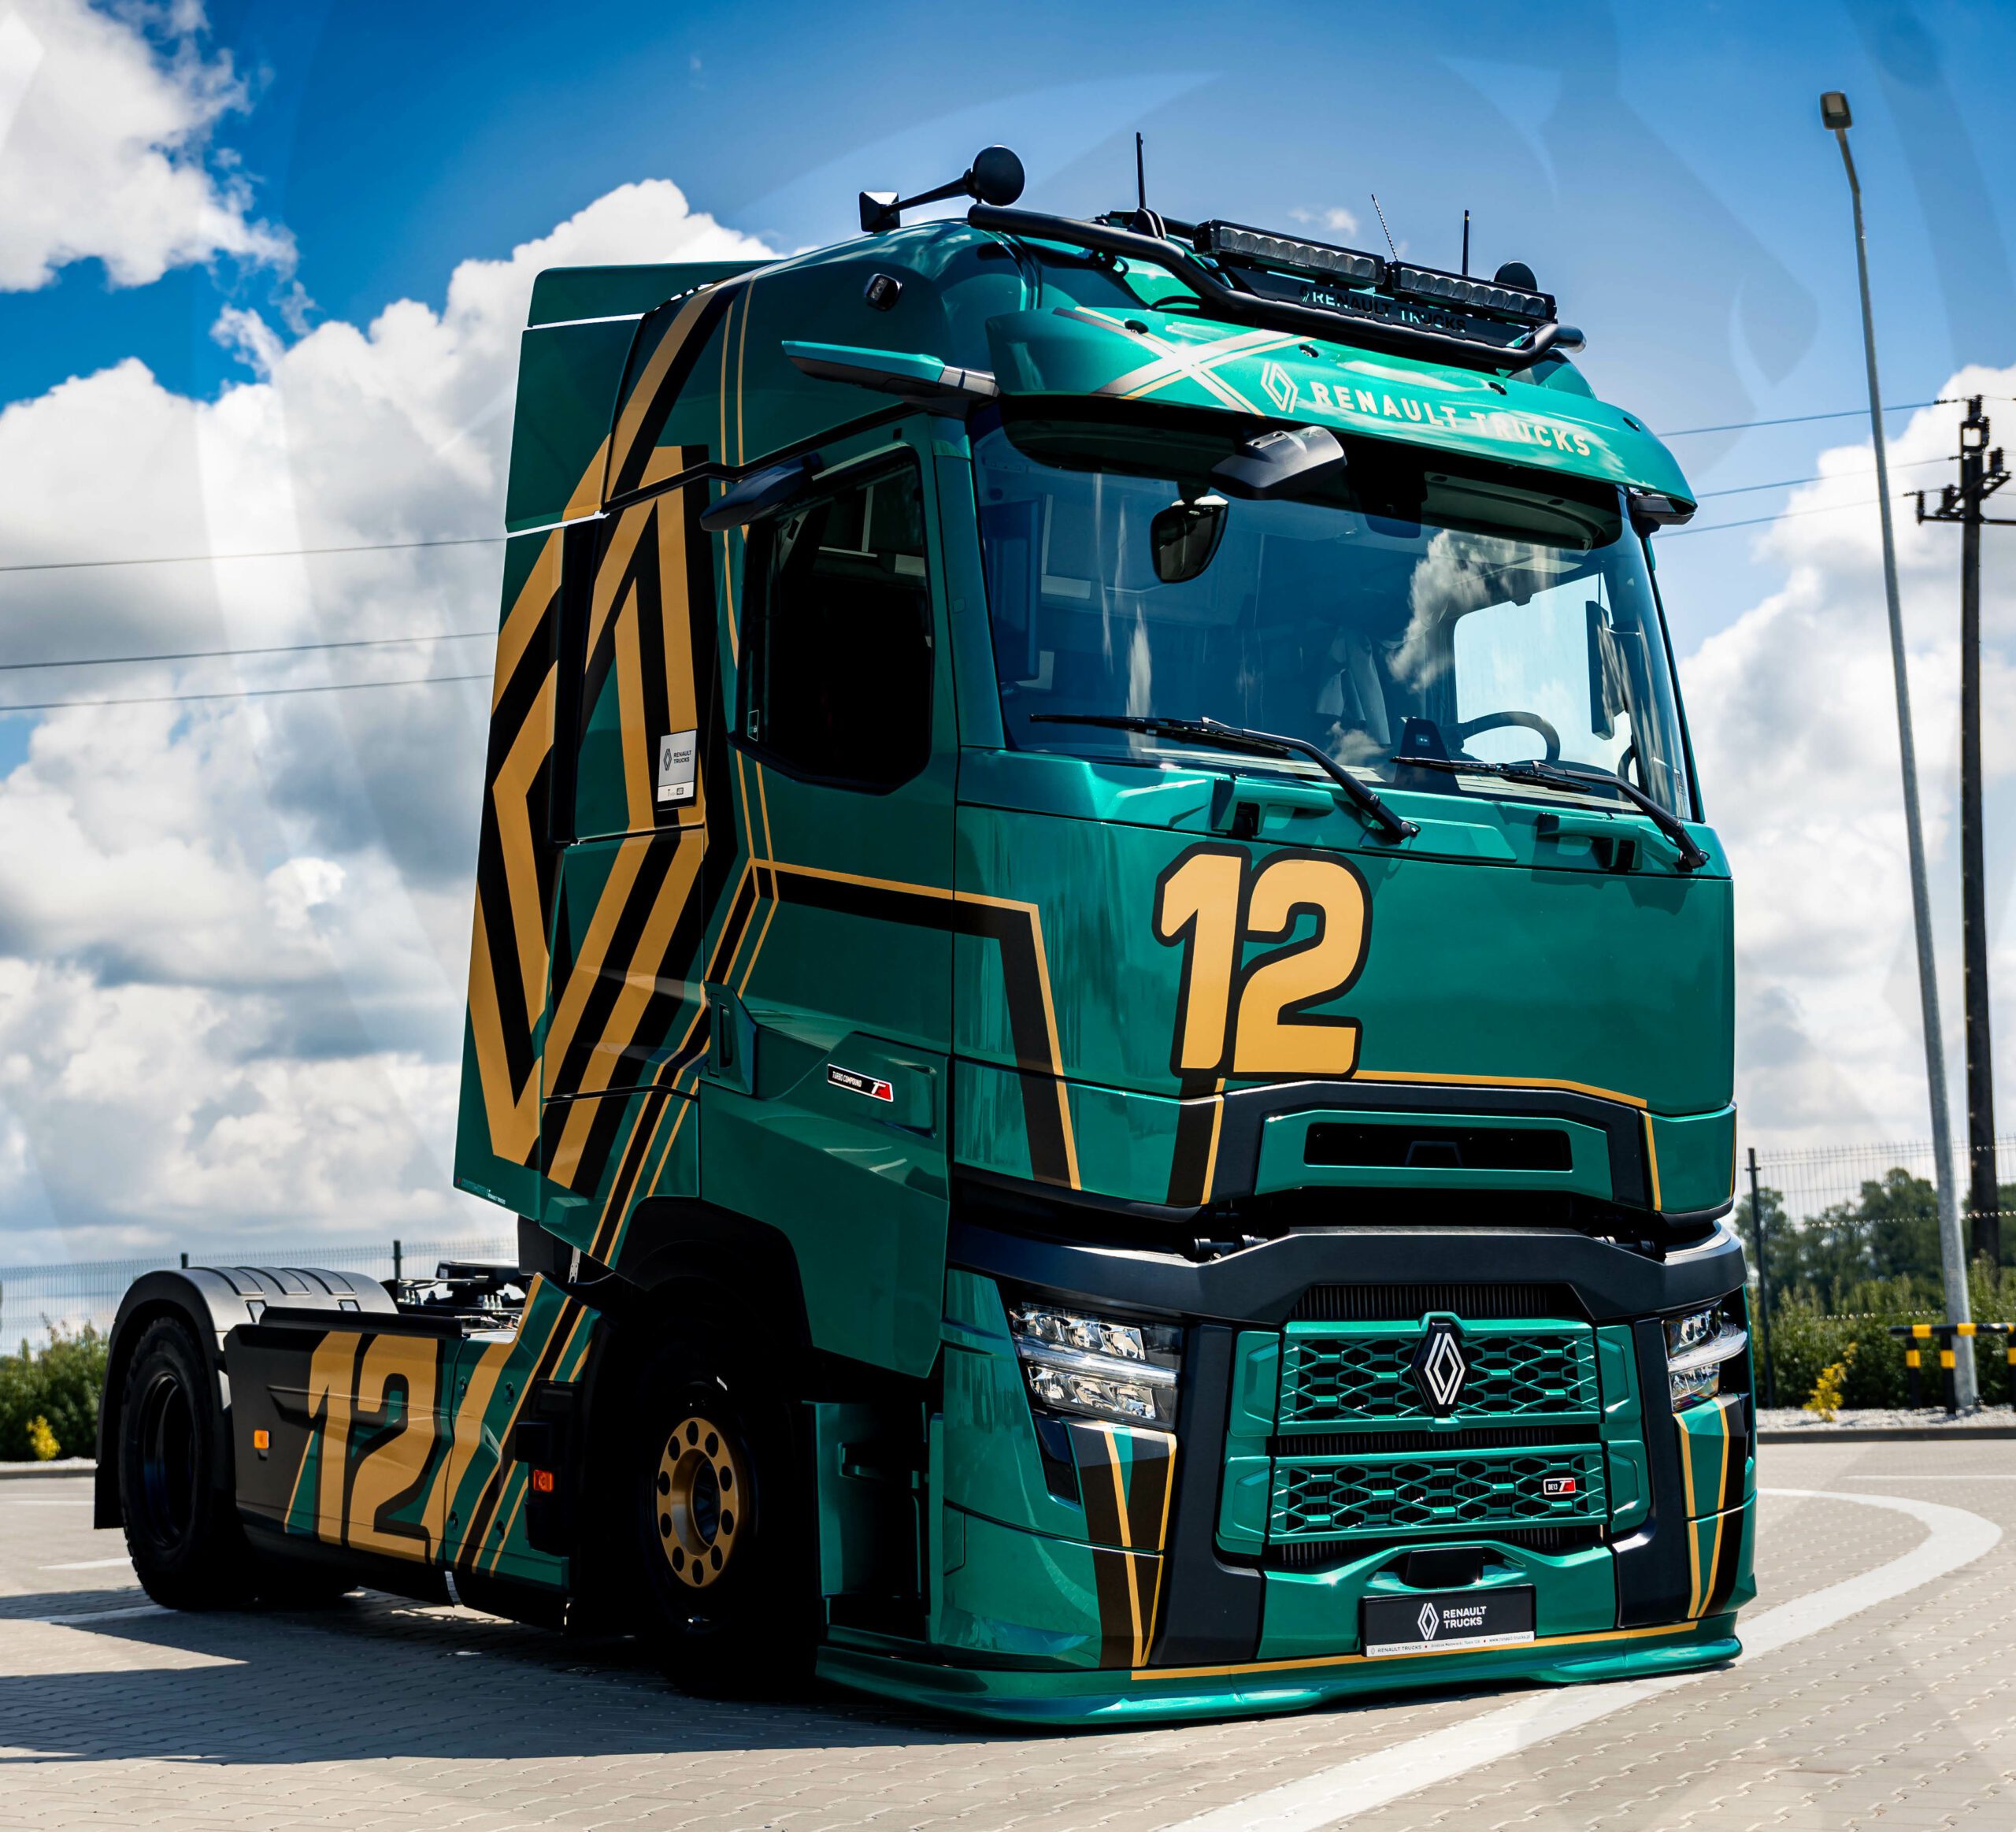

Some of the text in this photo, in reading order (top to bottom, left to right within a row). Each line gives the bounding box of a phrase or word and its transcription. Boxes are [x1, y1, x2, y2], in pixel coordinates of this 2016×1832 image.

[1313, 289, 1468, 332] RENAULT TRUCKS
[1310, 380, 1591, 457] RENAULT TRUCKS
[1156, 847, 1369, 1077] 12
[843, 1075, 862, 1088] COMPOUND
[308, 1330, 438, 1564] 12
[1443, 1606, 1487, 1619] RENAULT
[1443, 1617, 1483, 1629] TRUCKS
